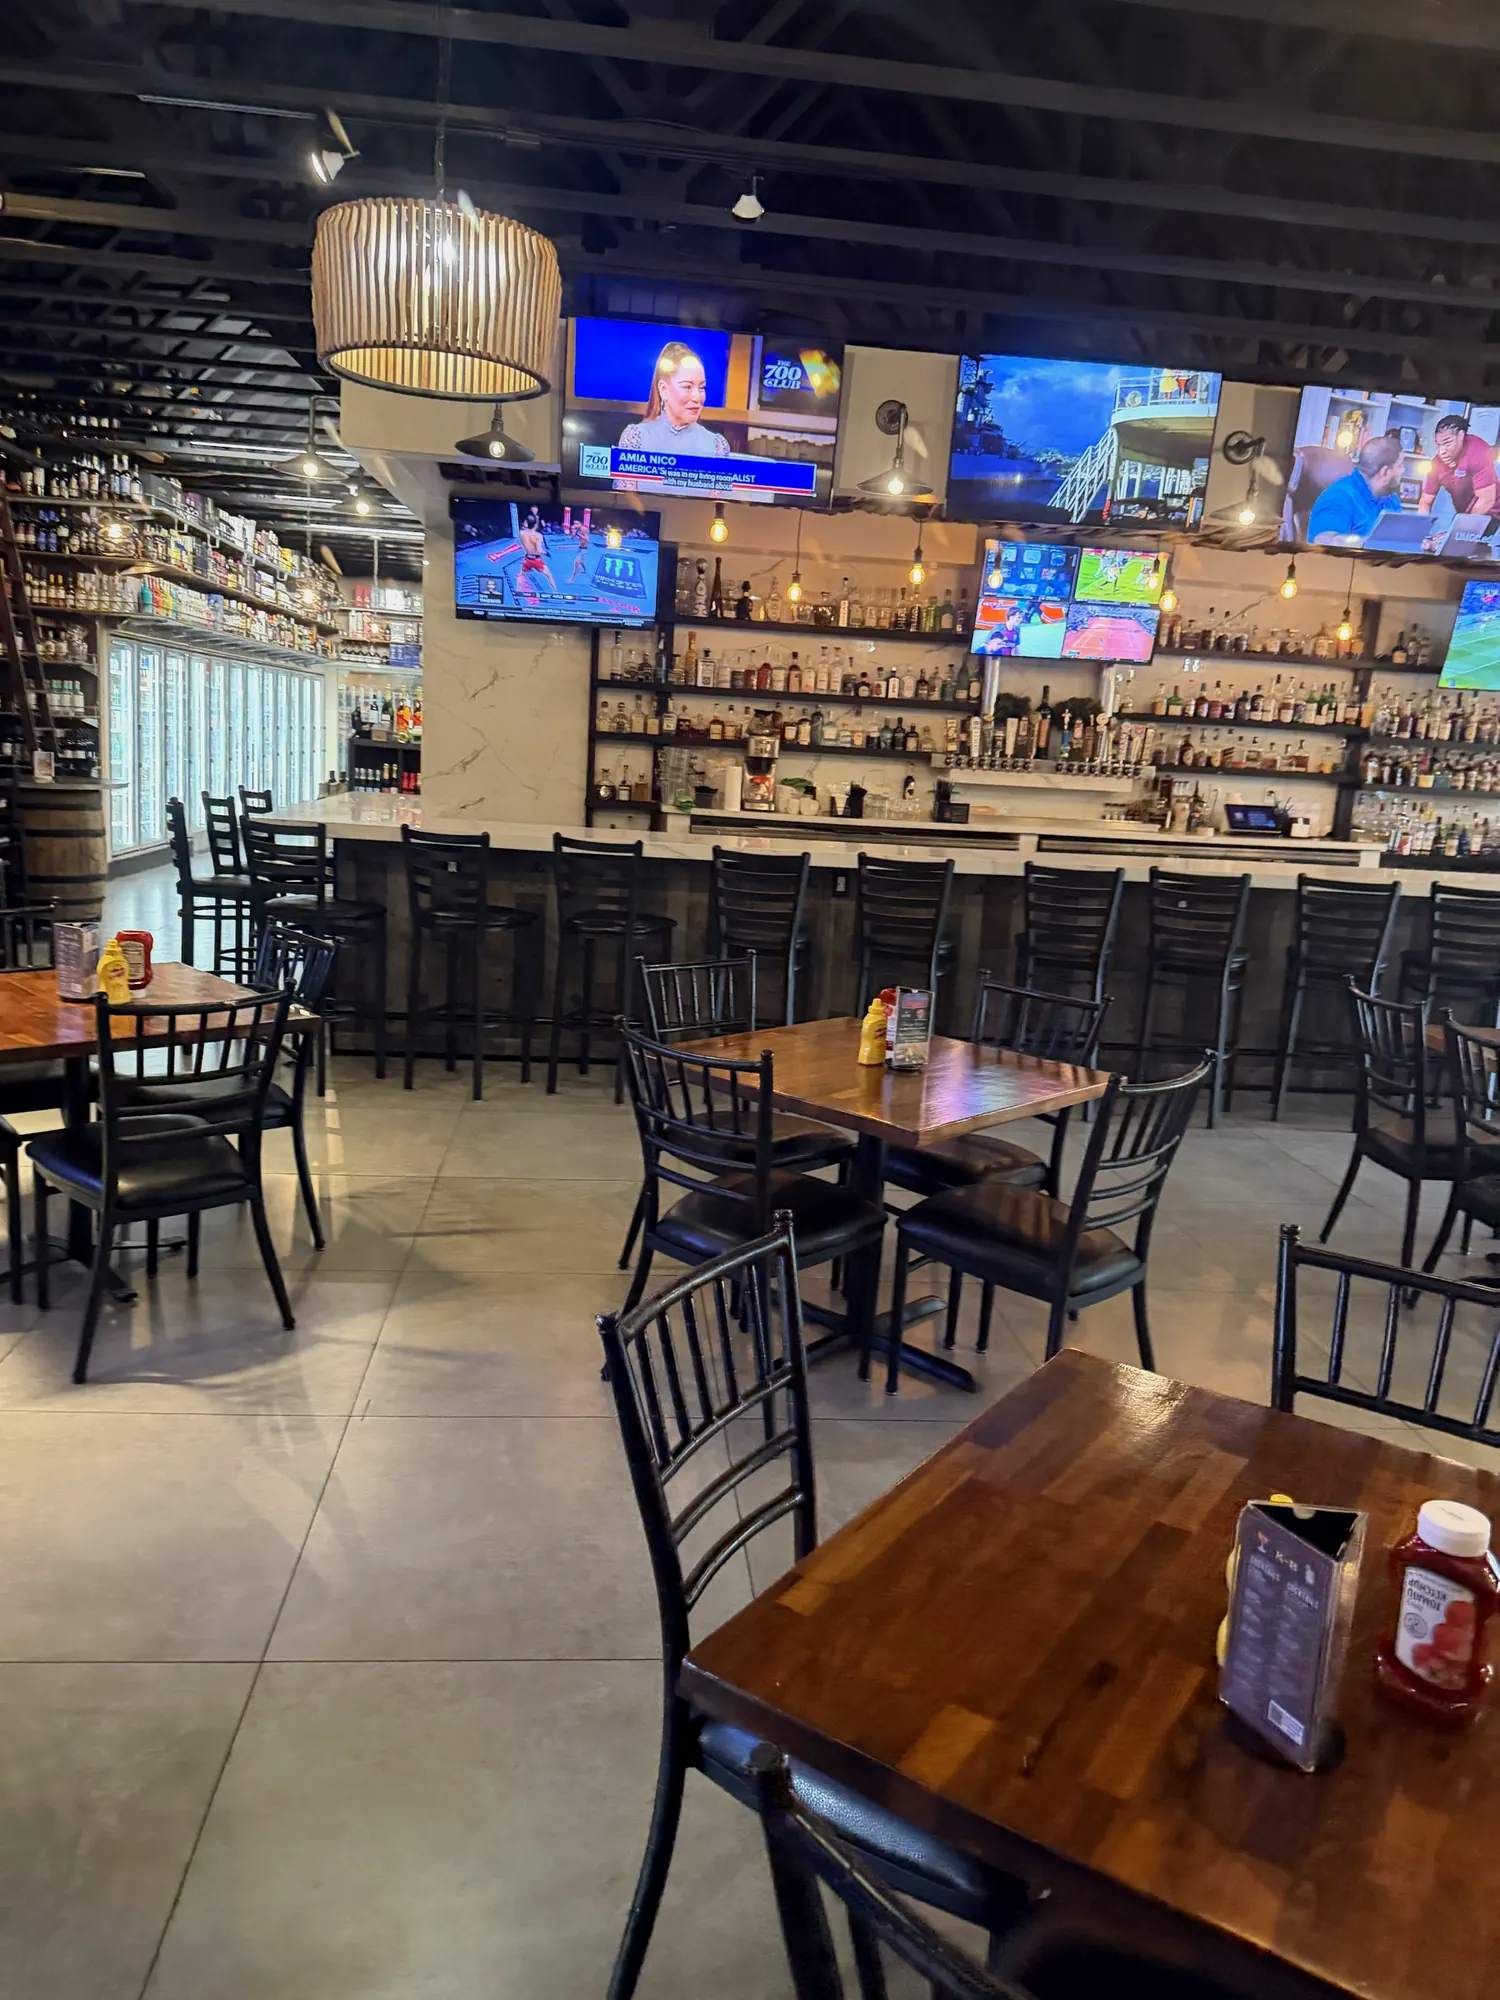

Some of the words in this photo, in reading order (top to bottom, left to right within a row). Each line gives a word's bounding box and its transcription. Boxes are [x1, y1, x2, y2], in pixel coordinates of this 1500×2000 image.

[765, 364, 802, 380] 700
[763, 378, 801, 389] CLUB
[585, 454, 608, 465] 700
[618, 452, 647, 464] AMIA
[649, 455, 677, 466] NICO
[618, 463, 665, 475] AMERICA'S
[688, 472, 698, 480] my
[1407, 1578, 1447, 1601] KETCHUP
[1406, 1587, 1441, 1611] TOMATO
